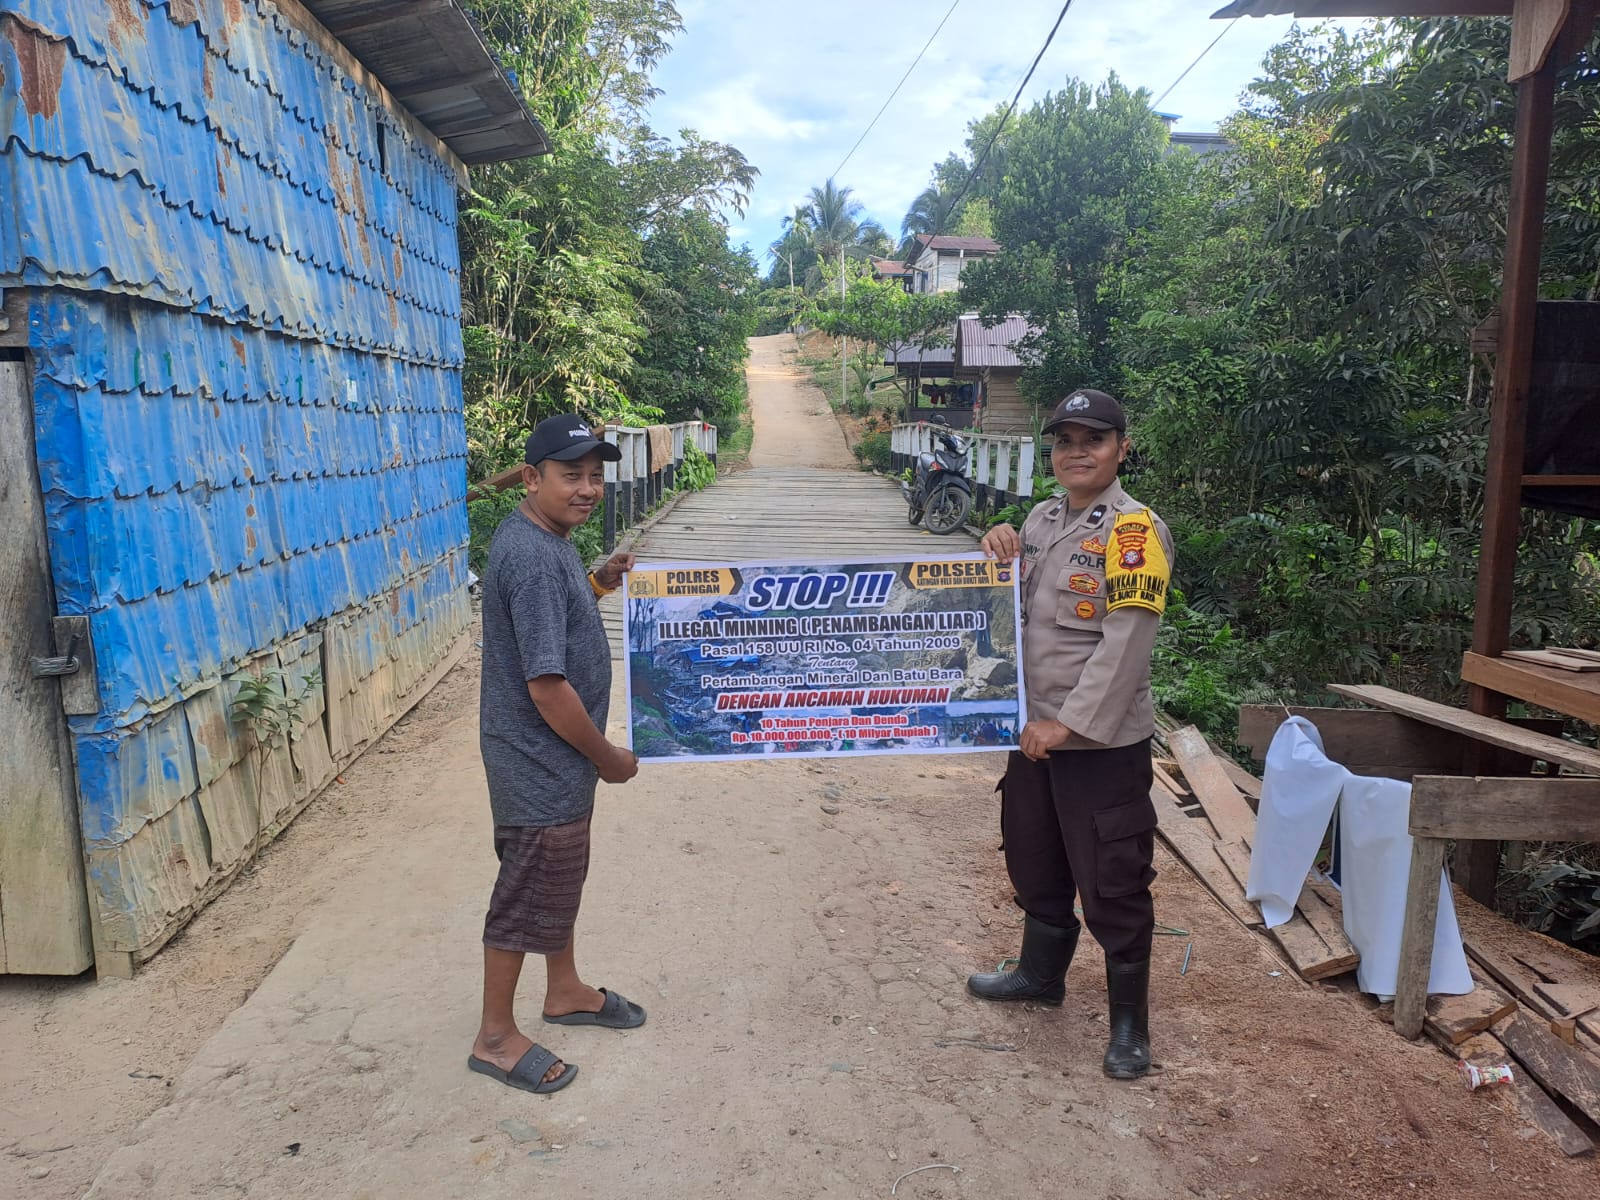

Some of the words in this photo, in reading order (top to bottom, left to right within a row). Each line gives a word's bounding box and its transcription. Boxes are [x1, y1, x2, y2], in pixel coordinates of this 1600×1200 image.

[1069, 553, 1106, 568] POLR
[667, 570, 720, 584] POLRES
[917, 563, 988, 577] POLSEK
[667, 584, 720, 595] KATINGAN
[749, 574, 847, 608] STOP
[850, 573, 894, 604] !!!
[659, 621, 721, 639] ILLEGAL
[725, 619, 797, 637] MINNING
[702, 643, 742, 656] Pasal
[747, 643, 773, 654] 158
[778, 642, 799, 653] UU
[805, 641, 820, 653] RI
[823, 640, 849, 652] No.
[854, 640, 871, 651] 04
[876, 638, 920, 650] Tahun
[923, 637, 961, 649] 2009
[808, 656, 857, 670] Tentang
[702, 674, 803, 688] Pertambangan
[808, 671, 857, 684] Mineral
[862, 671, 889, 681] Dan
[894, 670, 925, 681] Batu
[930, 669, 962, 680] Bara
[717, 693, 782, 710] DENGAN
[784, 690, 865, 708] ANCAMAN
[867, 687, 949, 705] HUKUMAN
[761, 719, 773, 728] 10
[775, 718, 807, 728] Tahun
[809, 716, 849, 728] Penjara
[851, 716, 871, 725] Dan
[874, 715, 907, 725] Denda
[732, 733, 749, 742] Rp.
[858, 727, 891, 739] Milyar
